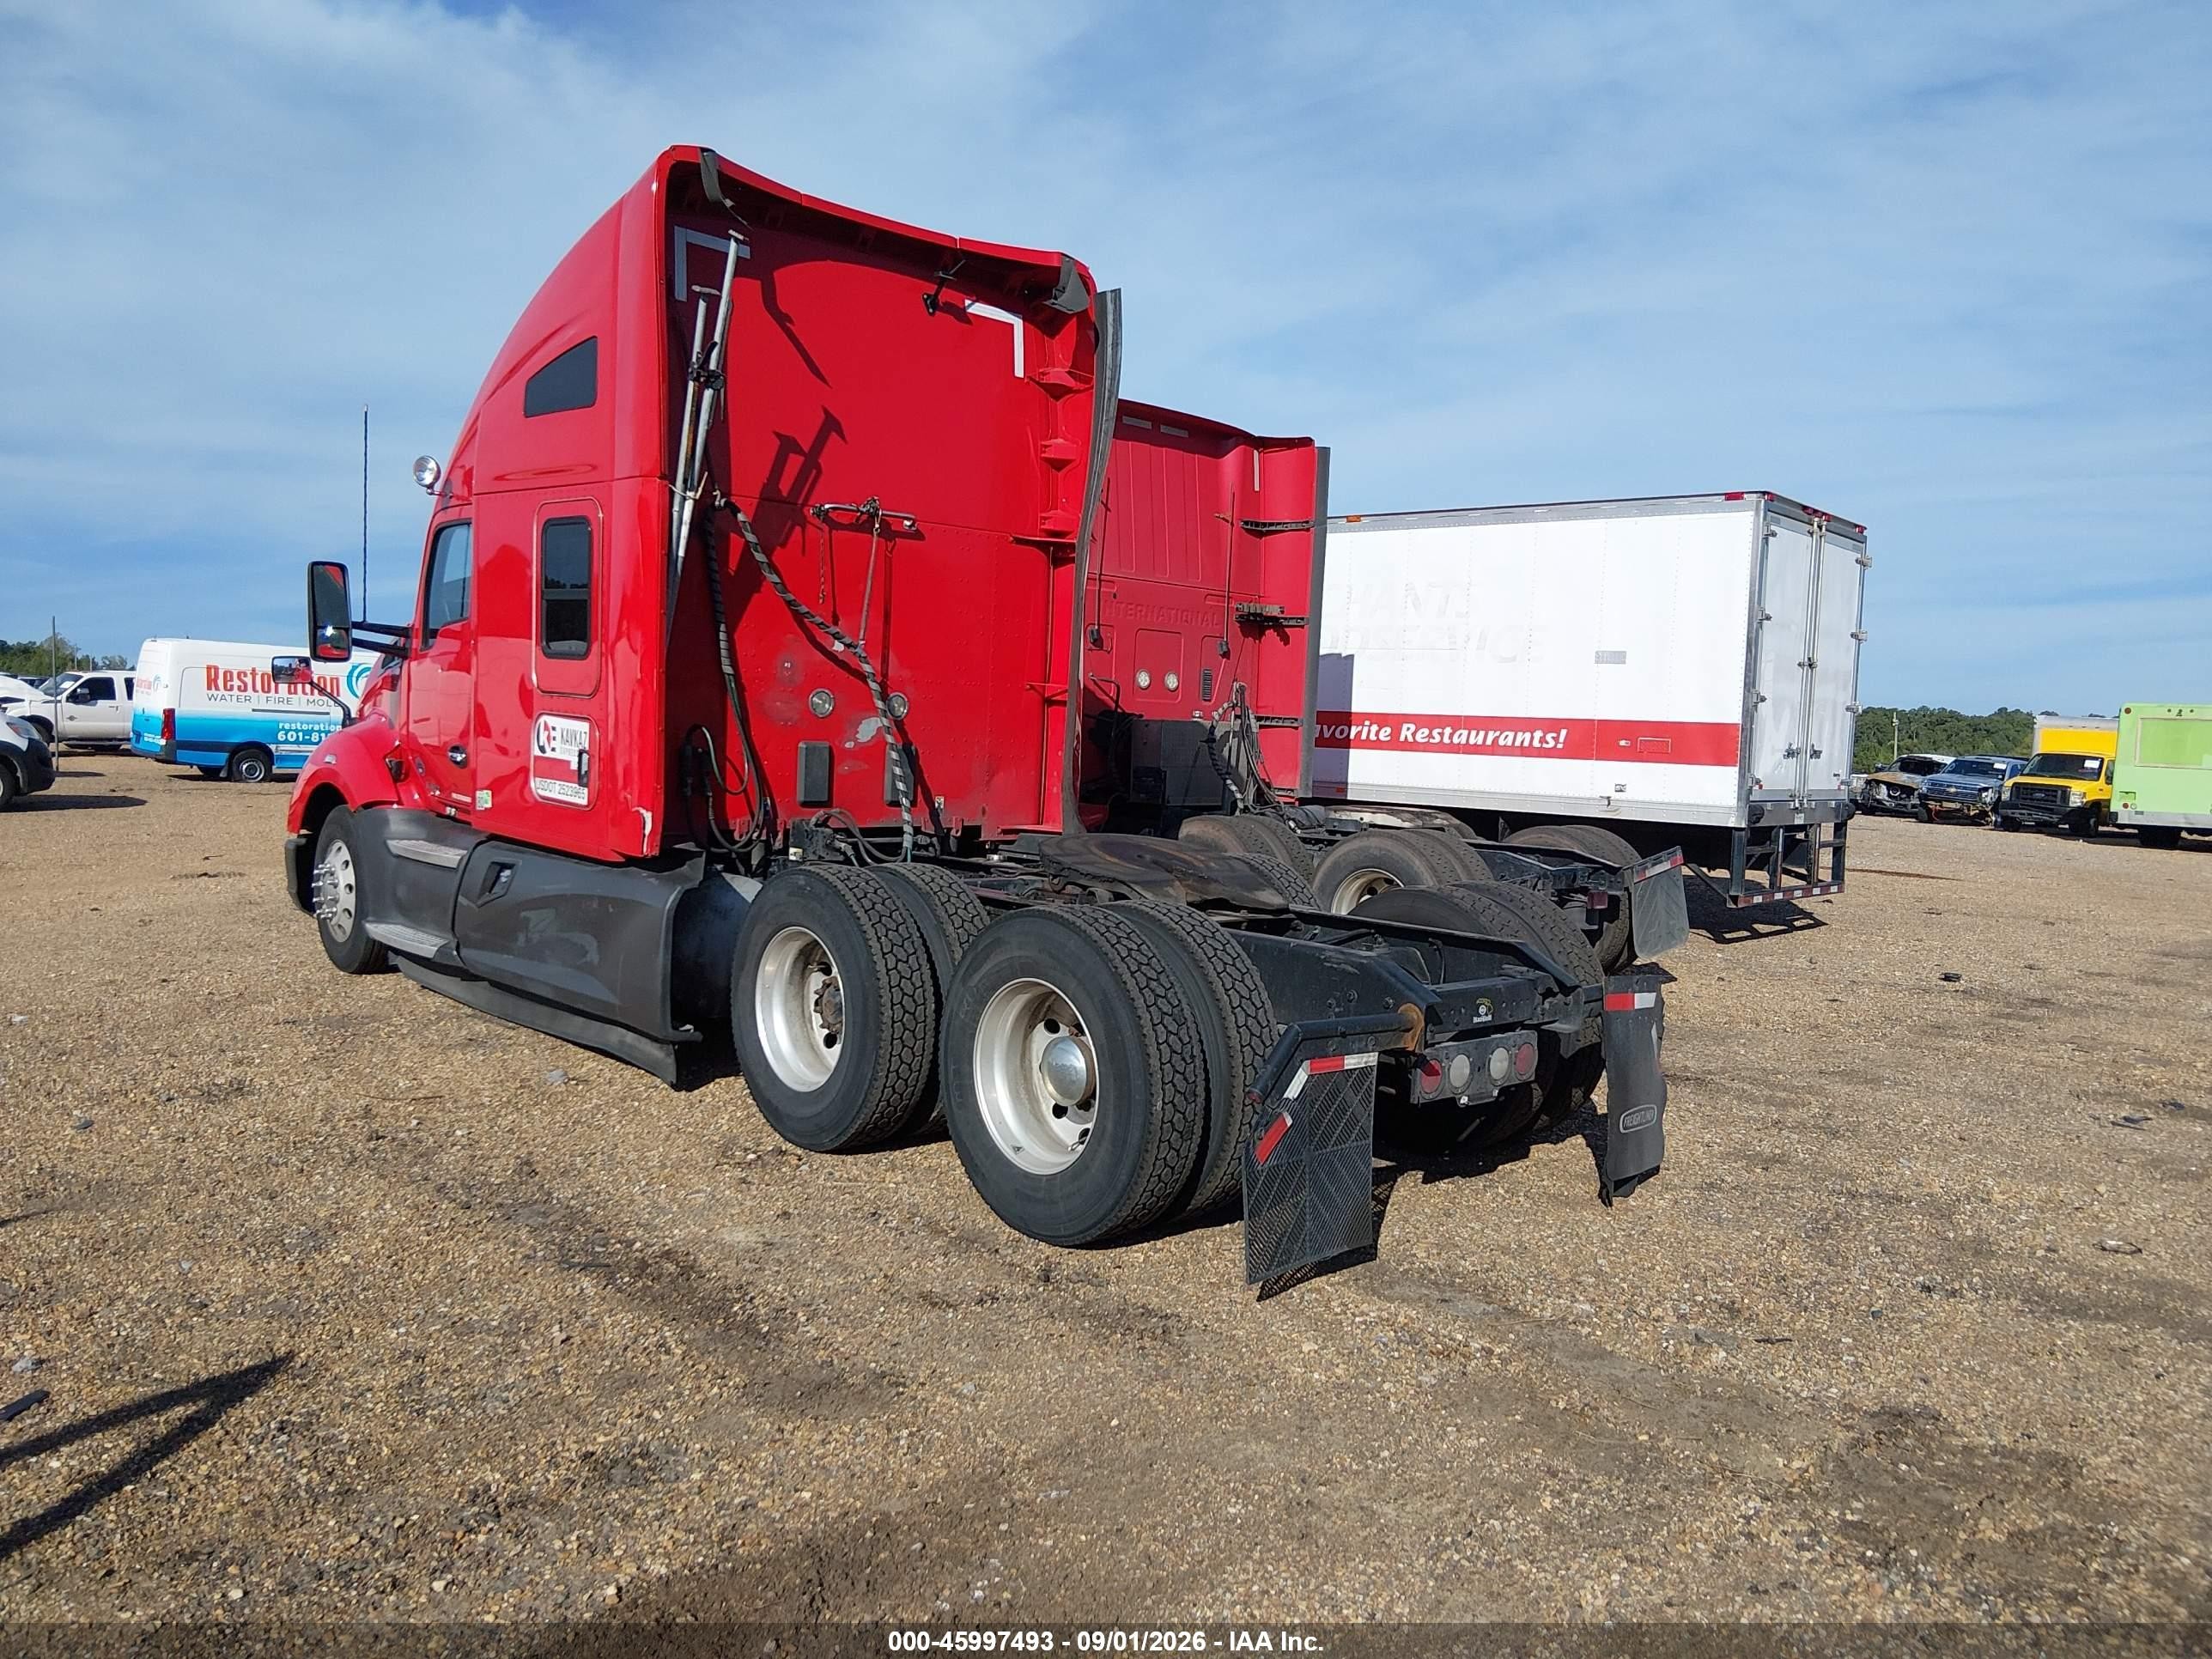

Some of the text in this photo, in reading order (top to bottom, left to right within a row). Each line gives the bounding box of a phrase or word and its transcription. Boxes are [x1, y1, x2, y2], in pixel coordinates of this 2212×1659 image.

[206, 693, 252, 703] WATER
[266, 696, 293, 705] FIRE
[277, 731, 330, 743] 601-81
[561, 727, 588, 750] KAVKAZ
[1399, 722, 1568, 750] Restaurants!
